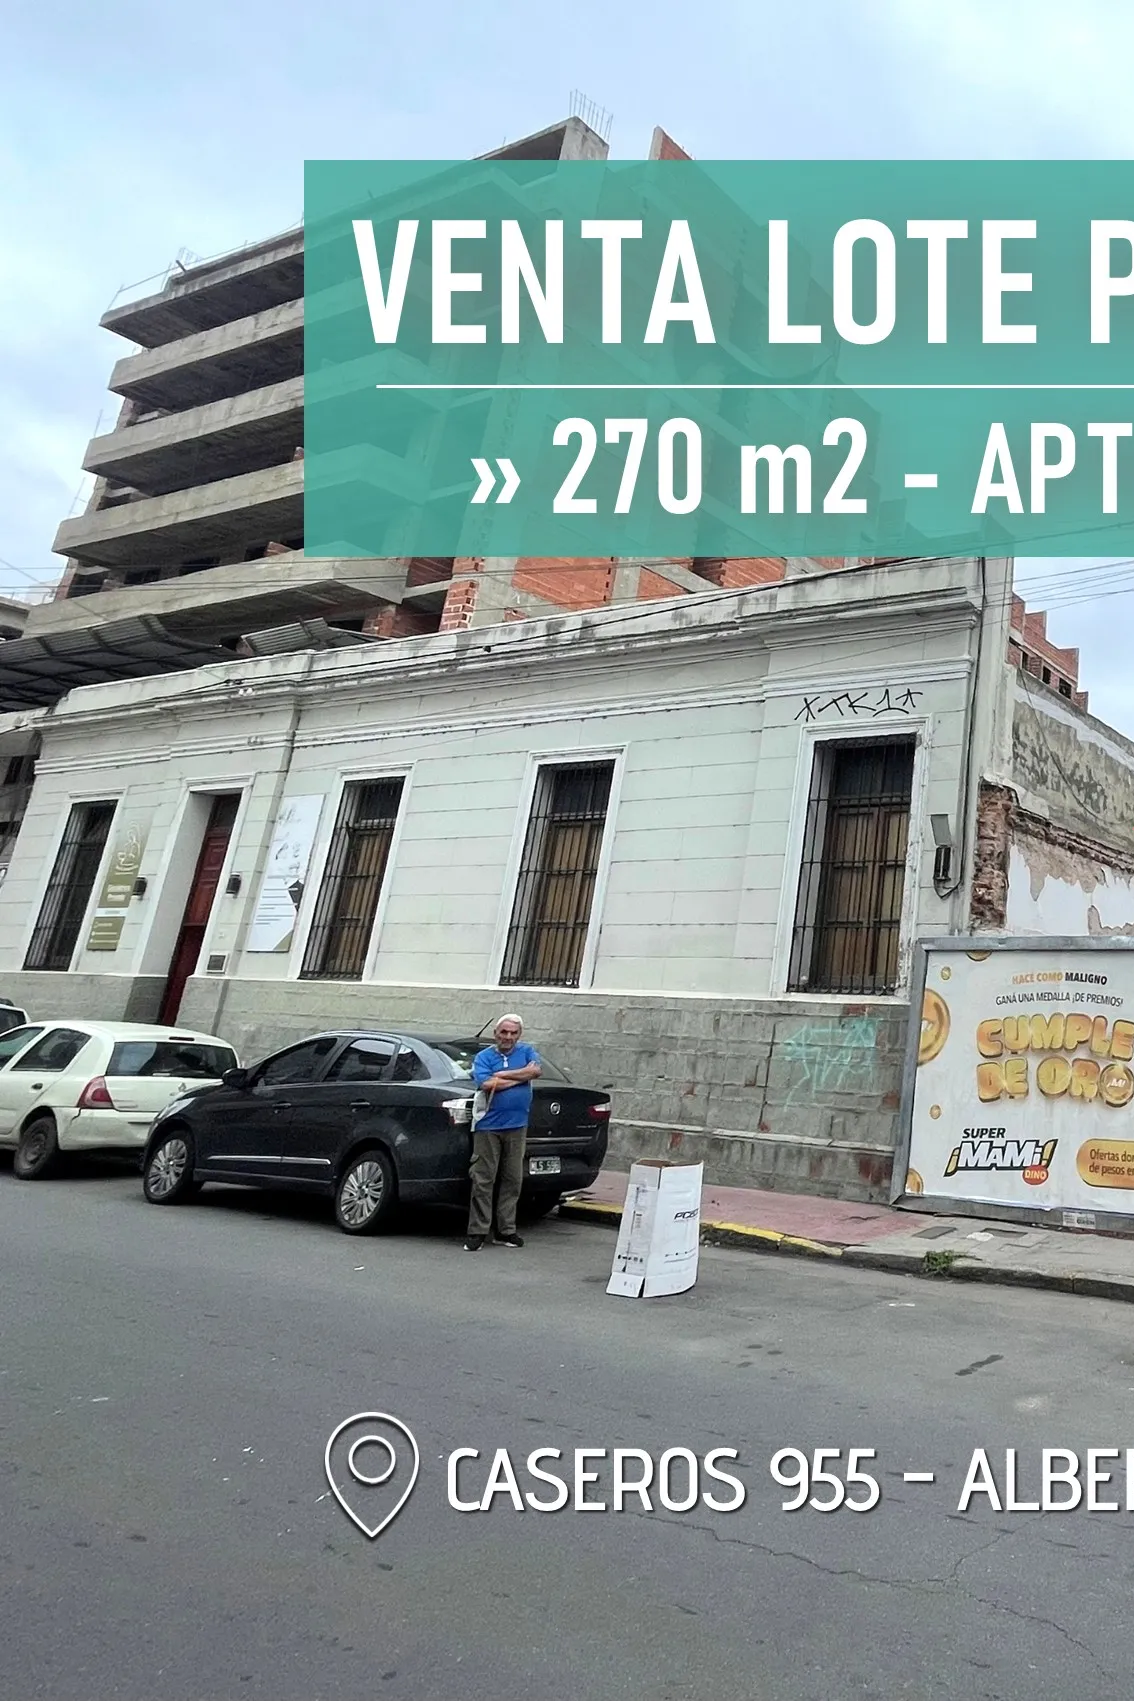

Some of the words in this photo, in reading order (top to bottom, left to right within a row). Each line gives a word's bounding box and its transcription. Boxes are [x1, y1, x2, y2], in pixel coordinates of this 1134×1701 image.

[1012, 972, 1035, 985] HACE
[1036, 972, 1064, 983] COMO
[1065, 972, 1108, 986] MALIGNO
[995, 992, 1017, 1006] GANÁ
[1018, 992, 1035, 1003] UNA
[1036, 992, 1071, 1002] MEDALLA
[1087, 993, 1124, 1008] PREMIOS!
[976, 1058, 1029, 1104] DE
[962, 1127, 1006, 1139] SUPER
[1089, 1149, 1119, 1162] Ofertas
[1024, 1169, 1047, 1180] DINO
[1089, 1162, 1099, 1173] de
[1101, 1165, 1125, 1176] pesos
